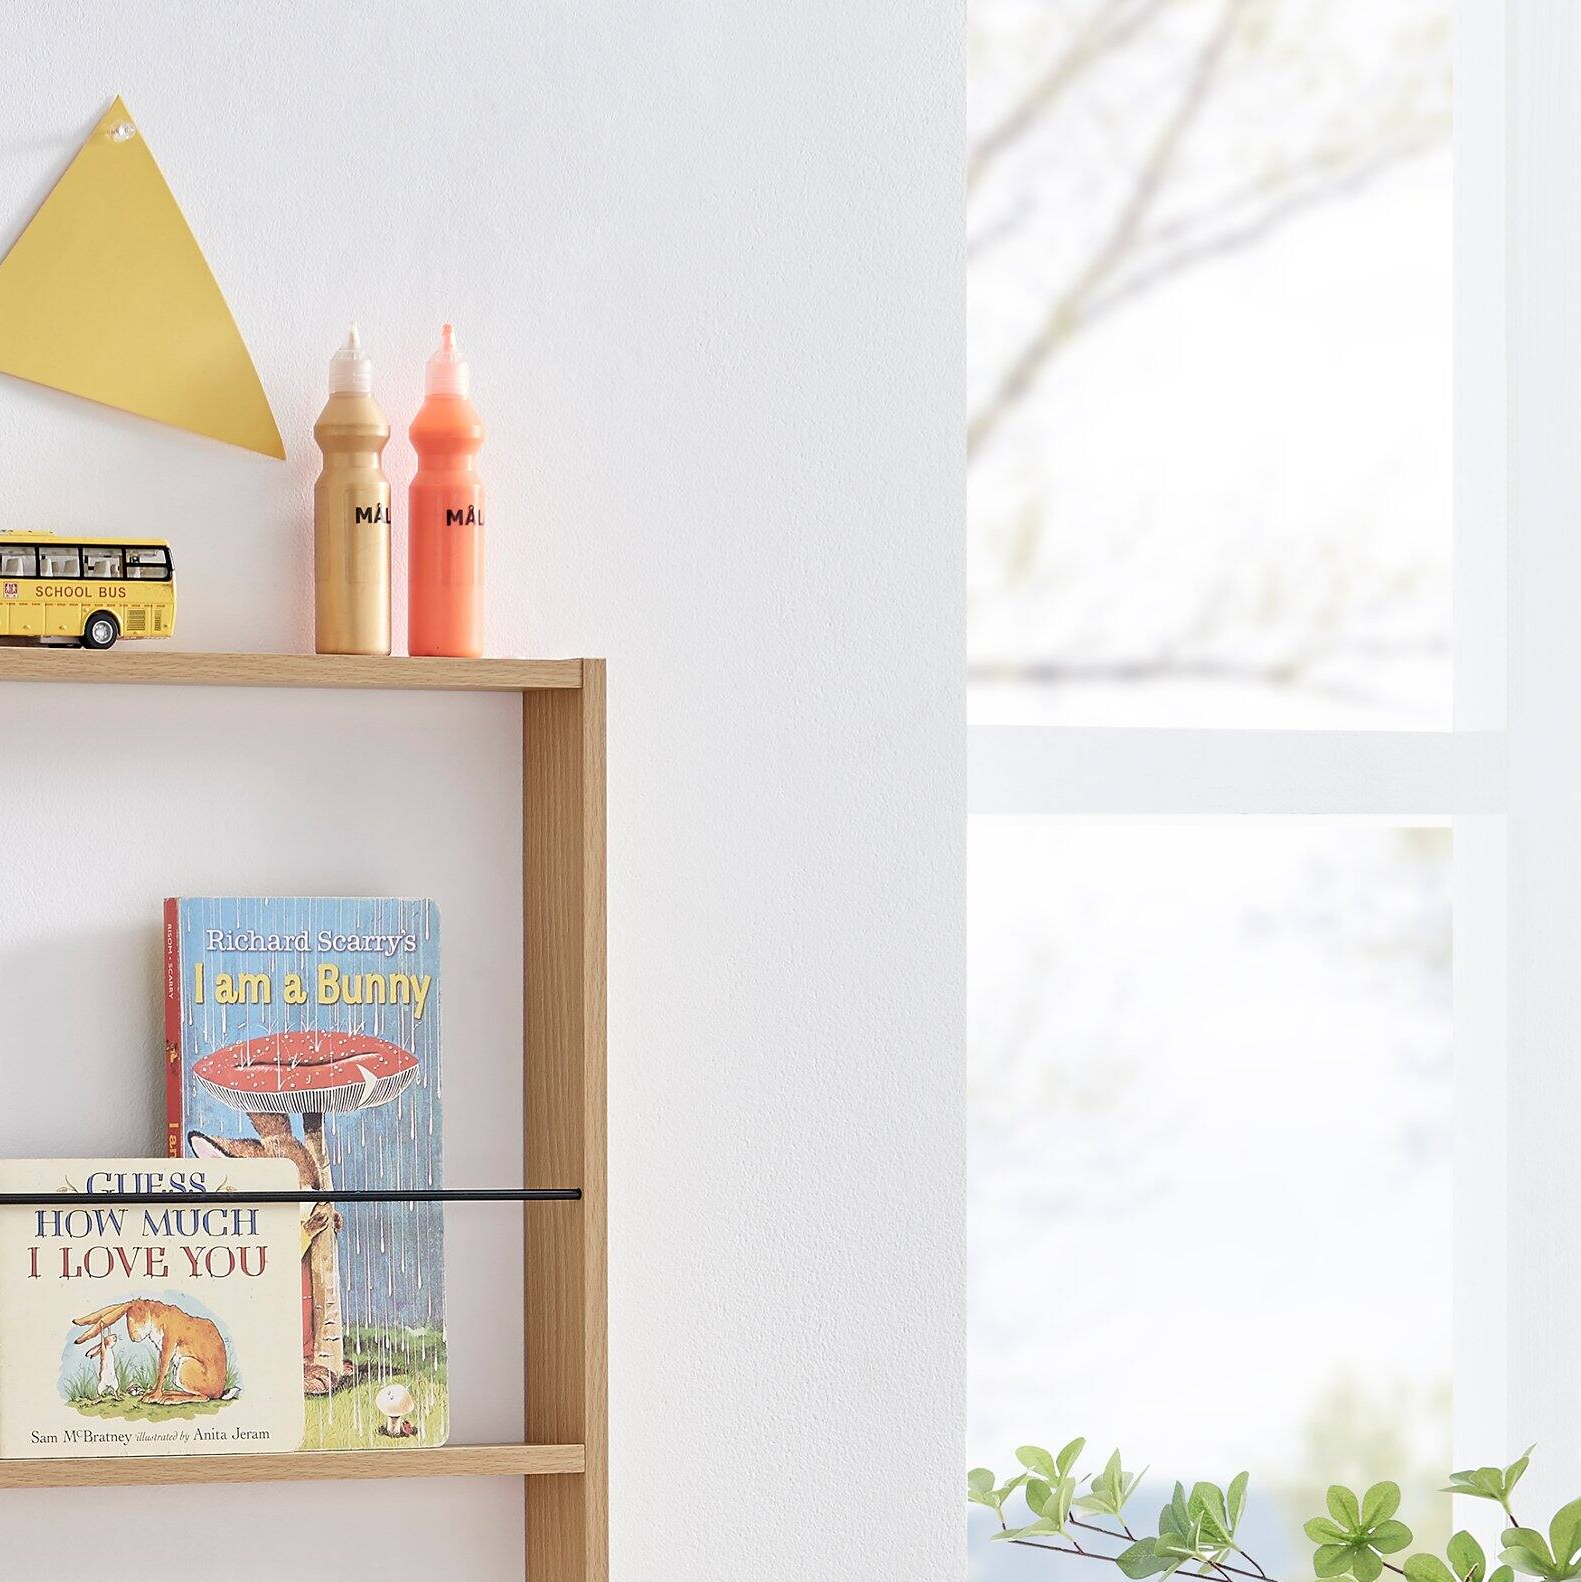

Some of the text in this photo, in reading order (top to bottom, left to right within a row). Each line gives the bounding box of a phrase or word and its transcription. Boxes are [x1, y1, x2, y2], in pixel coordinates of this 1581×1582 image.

[35, 586, 127, 599] SCHOOL BUS
[206, 929, 417, 956] Richard Scarry's
[194, 962, 431, 1020] I am a Bunny
[86, 1171, 206, 1195] GUESS
[34, 1208, 260, 1238] HOW MUCH
[27, 1245, 269, 1280] I LOVE YOU
[31, 1431, 58, 1444] Sam
[135, 1431, 178, 1442] illustrated
[180, 1430, 190, 1443] by
[193, 1428, 227, 1441] Anita
[232, 1427, 270, 1440] Jeram
